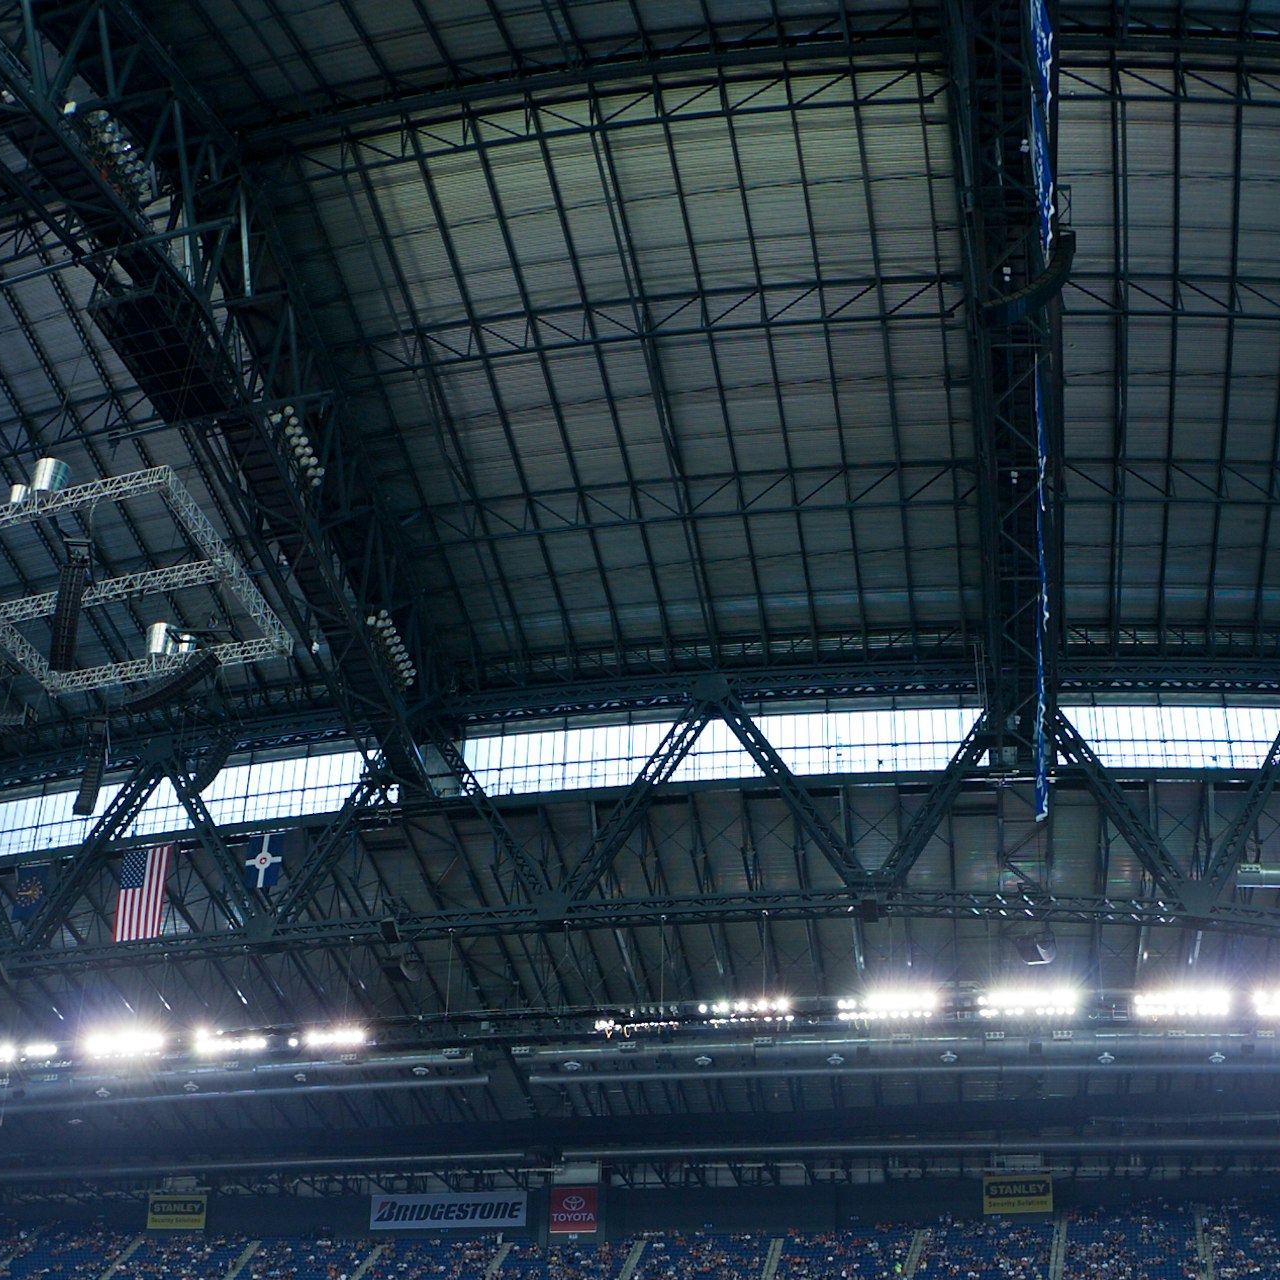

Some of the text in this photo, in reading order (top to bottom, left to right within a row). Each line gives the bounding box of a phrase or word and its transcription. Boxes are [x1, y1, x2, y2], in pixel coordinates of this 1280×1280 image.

[989, 1183, 1046, 1195] STANLEY
[154, 1202, 202, 1214] STANLEY
[375, 1199, 523, 1222] BRIDGESTONE
[551, 1212, 596, 1224] TOYOTA
